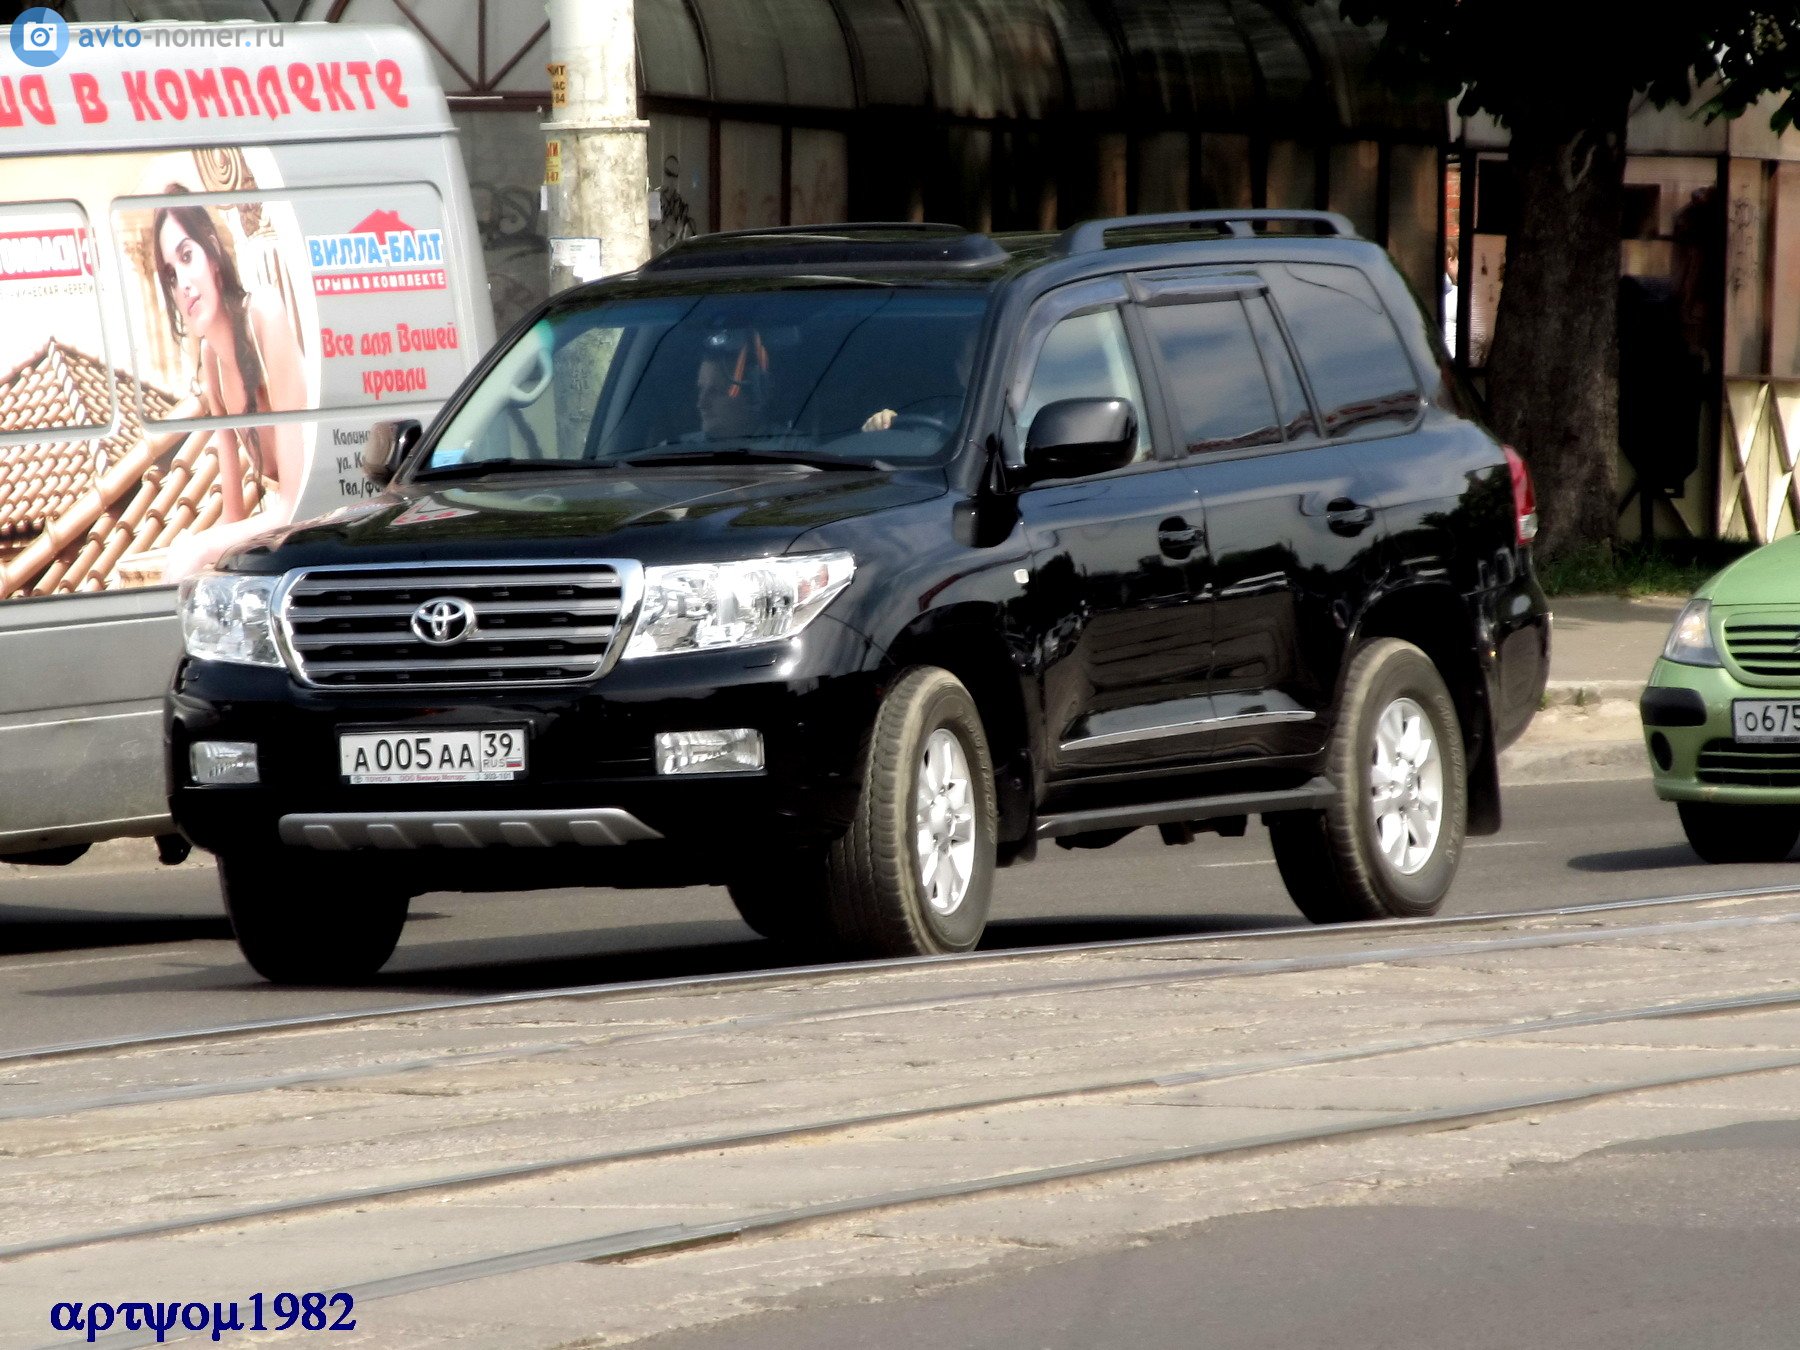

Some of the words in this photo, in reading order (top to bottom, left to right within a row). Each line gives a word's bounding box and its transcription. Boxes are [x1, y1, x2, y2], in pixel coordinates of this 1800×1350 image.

[121, 58, 409, 121] комплекте
[308, 233, 441, 267] ВИЛЛА-БАЛТ
[315, 277, 362, 292] КРЫША
[362, 276, 371, 289] В
[372, 272, 445, 289] КОМПЛЕКТЕ
[321, 327, 355, 358] Все
[361, 331, 392, 356] для
[396, 322, 458, 353] Вашей
[362, 367, 427, 400] кровли
[354, 737, 475, 772] А005АА
[484, 733, 513, 757] 39
[482, 758, 505, 769] RUS
